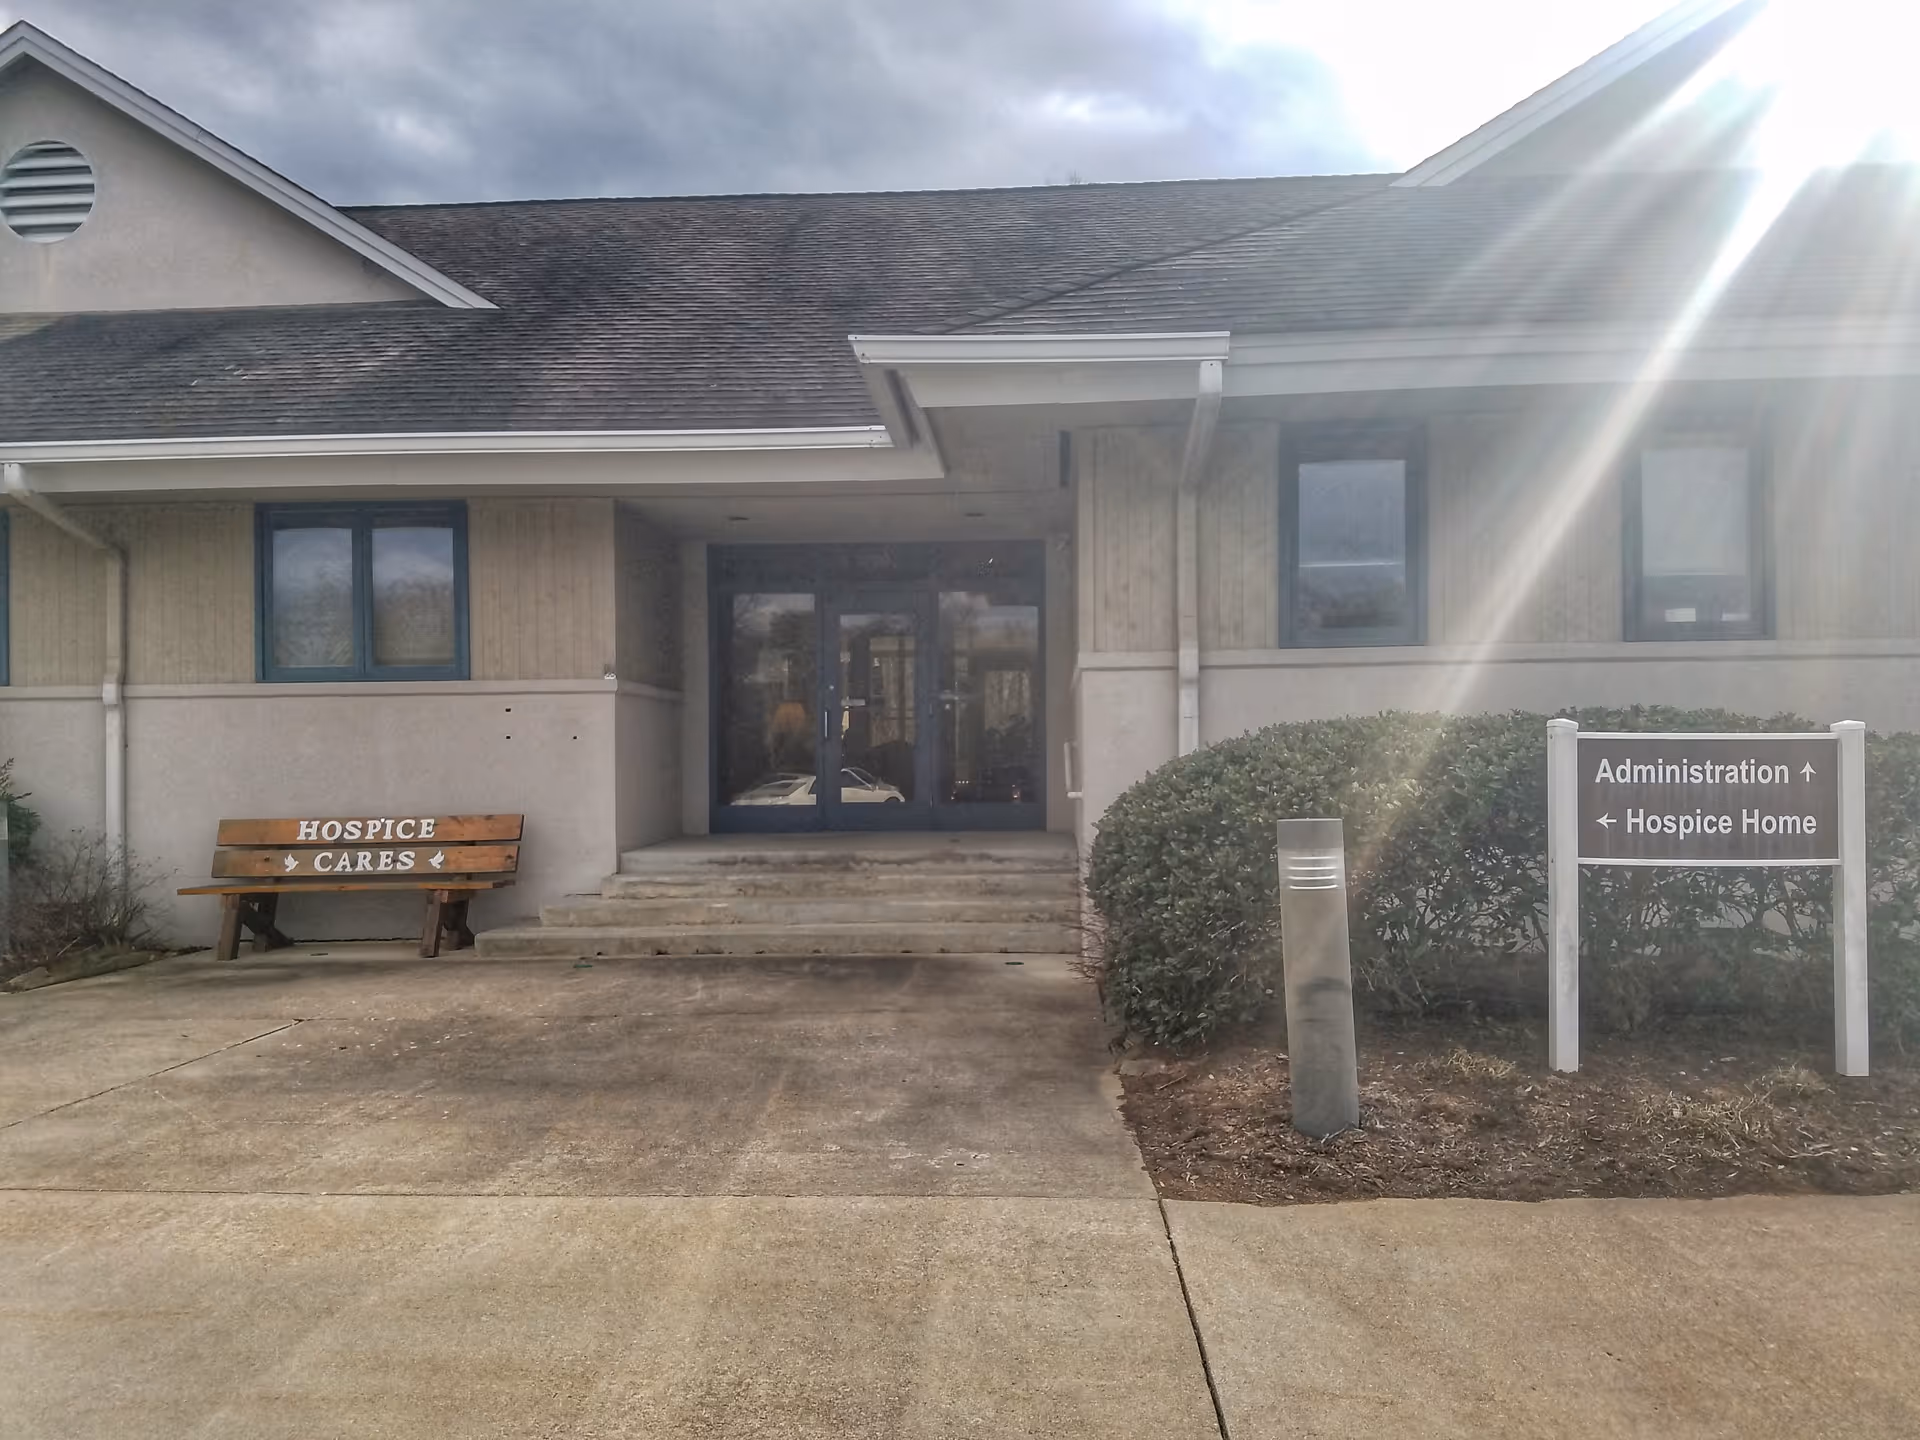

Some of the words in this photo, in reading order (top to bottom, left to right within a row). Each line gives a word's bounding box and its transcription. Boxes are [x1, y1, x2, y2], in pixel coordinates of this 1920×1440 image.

[1594, 758, 1789, 784] Administration
[296, 818, 436, 842] HOSPICE
[1626, 808, 1732, 840] Hospice
[1742, 808, 1817, 834] Home
[313, 850, 416, 873] CARES
